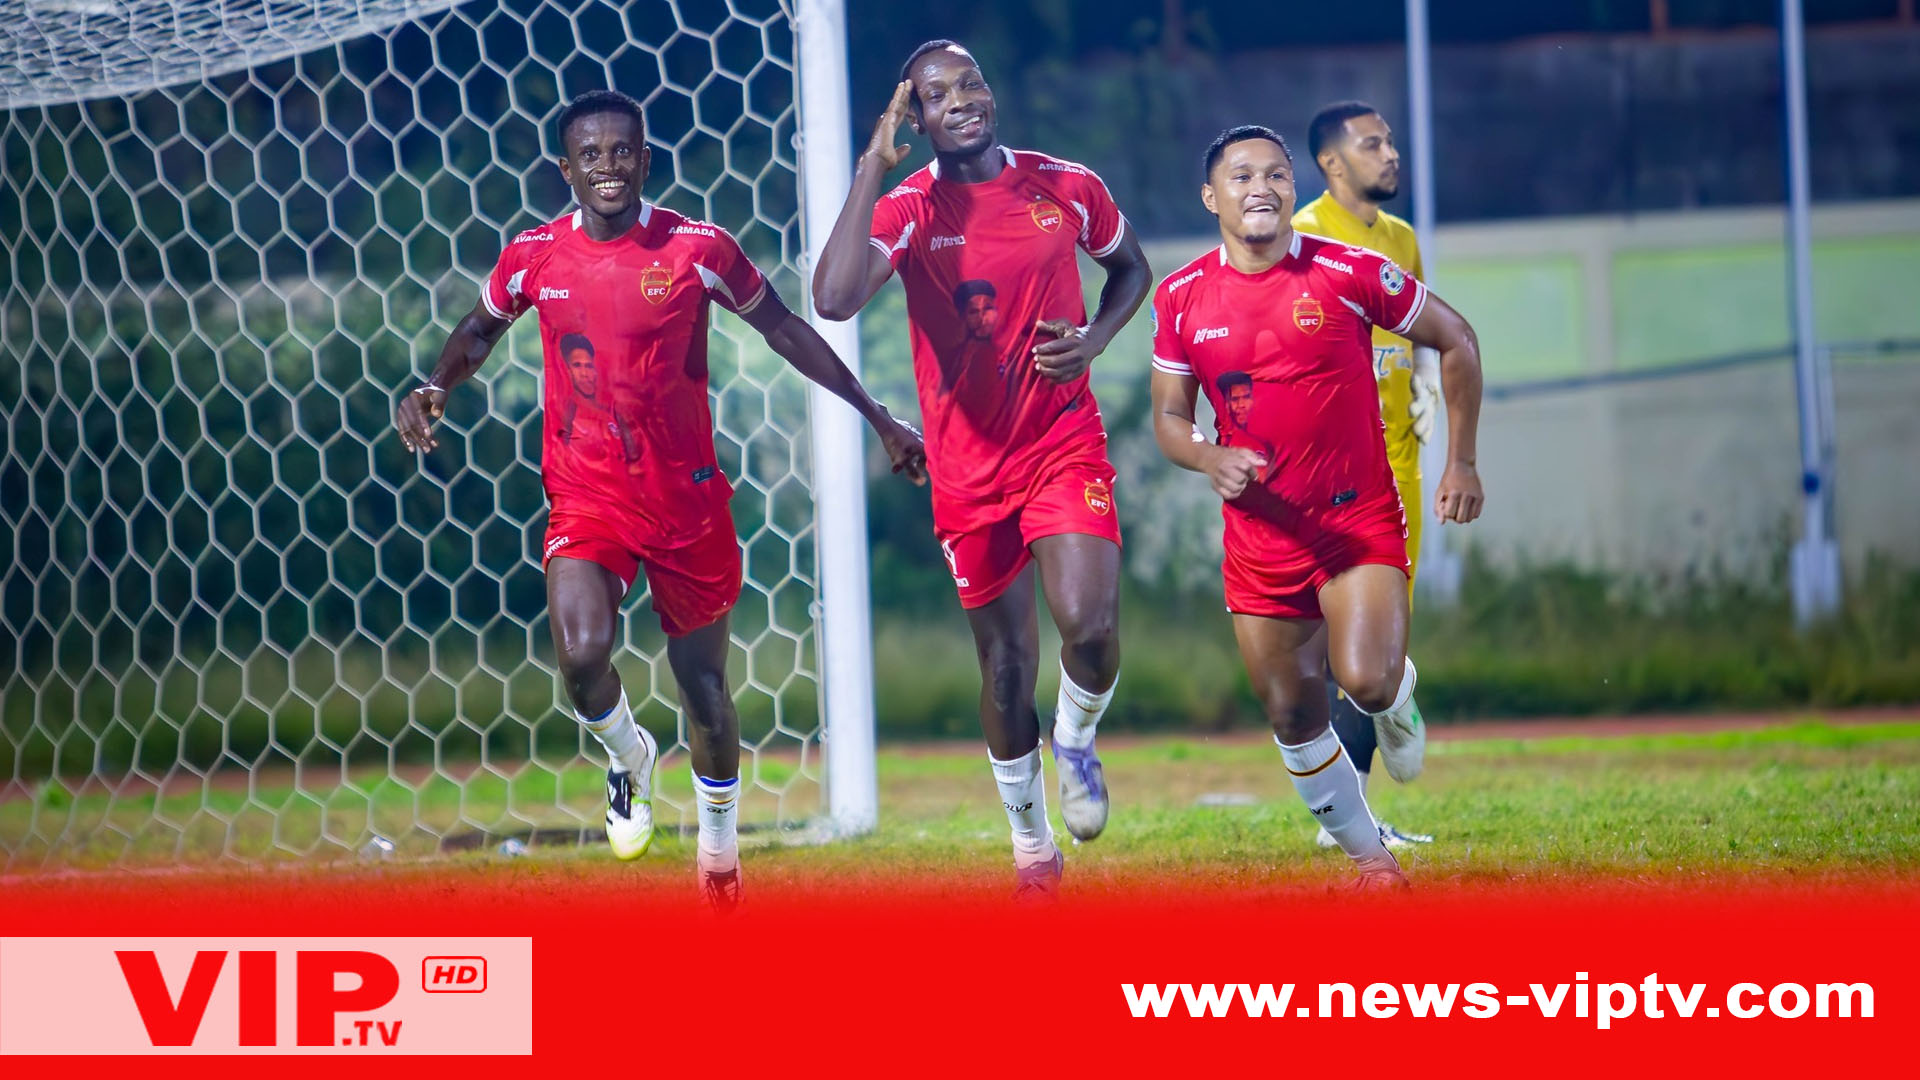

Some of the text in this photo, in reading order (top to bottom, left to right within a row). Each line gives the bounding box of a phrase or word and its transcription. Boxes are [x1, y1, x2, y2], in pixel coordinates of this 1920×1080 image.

[1038, 162, 1088, 176] ARMADA
[1041, 217, 1059, 227] EFC
[668, 226, 716, 239] ARMADA
[512, 233, 554, 245] AVANCA
[1312, 254, 1353, 275] ARMADA
[648, 287, 666, 296] EFC
[1299, 318, 1319, 326] EFC
[1091, 498, 1107, 509] EFC
